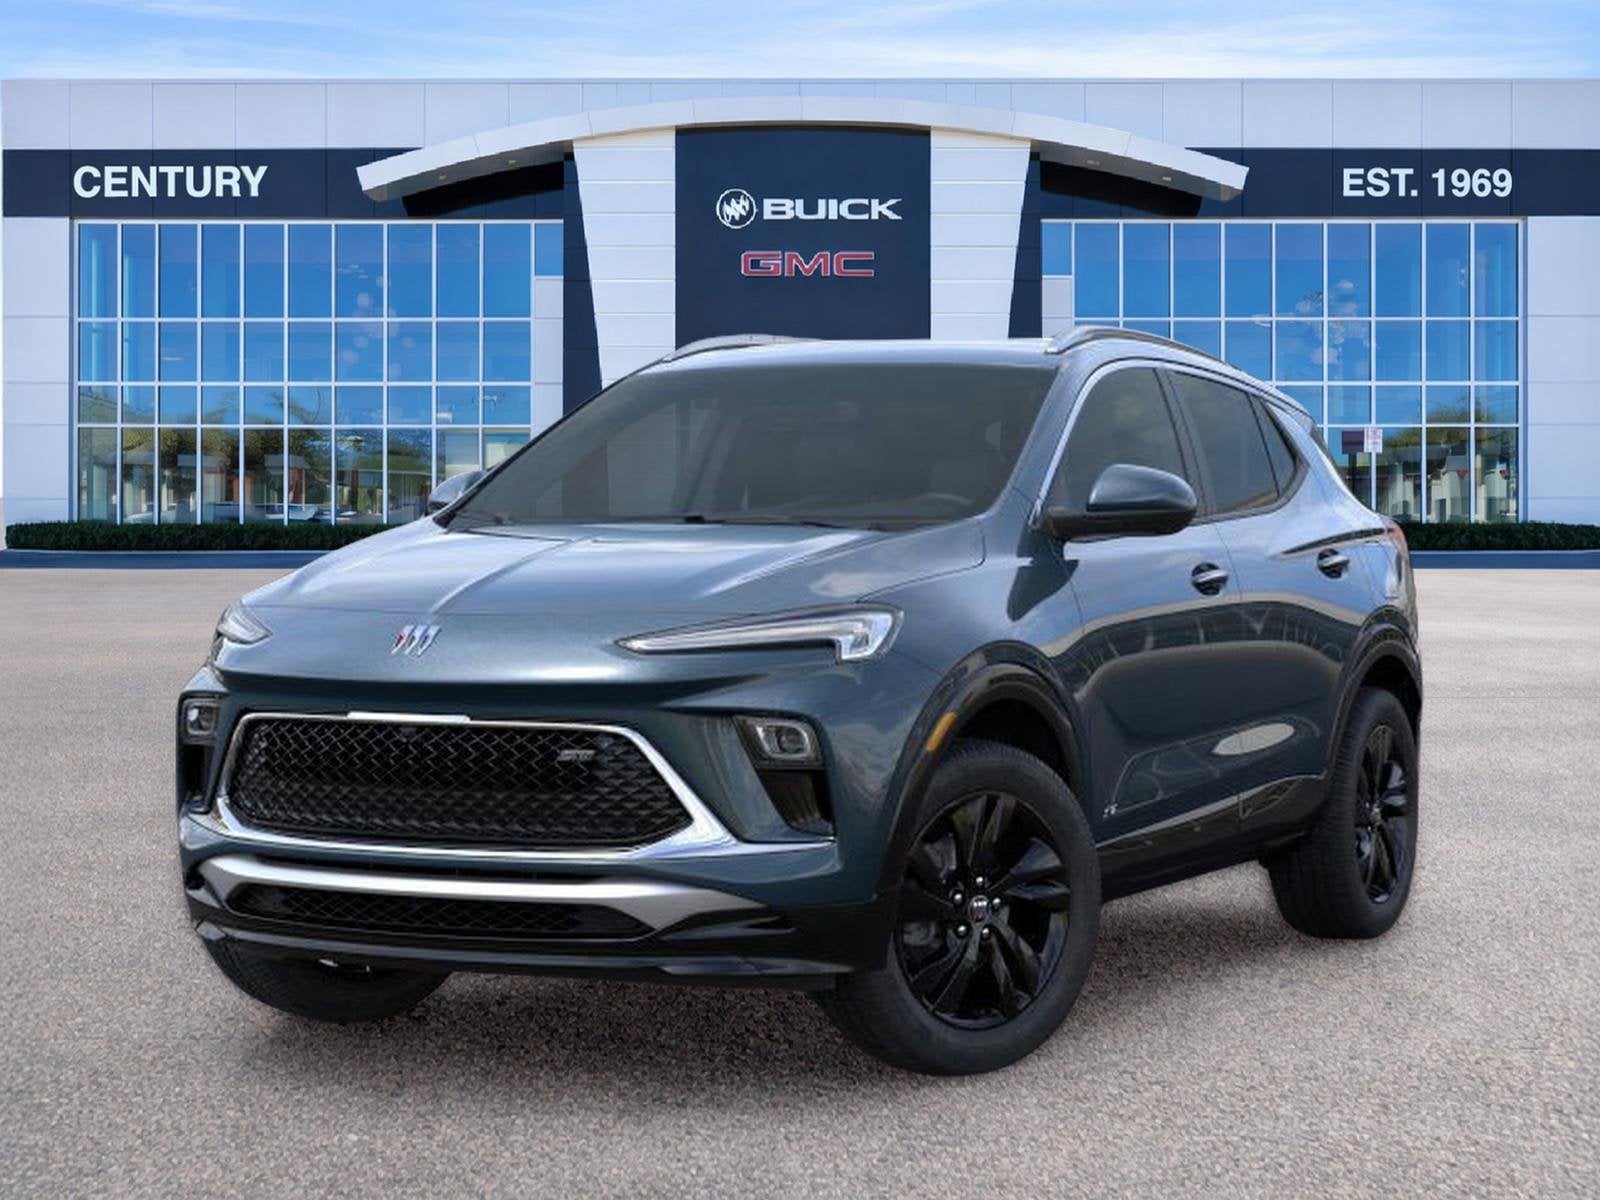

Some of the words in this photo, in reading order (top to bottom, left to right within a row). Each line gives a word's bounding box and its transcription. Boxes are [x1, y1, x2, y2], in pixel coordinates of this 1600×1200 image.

[73, 165, 268, 198] CENTURY
[1342, 167, 1419, 198] EST.
[1431, 167, 1513, 198] 1969
[763, 198, 903, 220] BUICK
[741, 251, 875, 277] GMC
